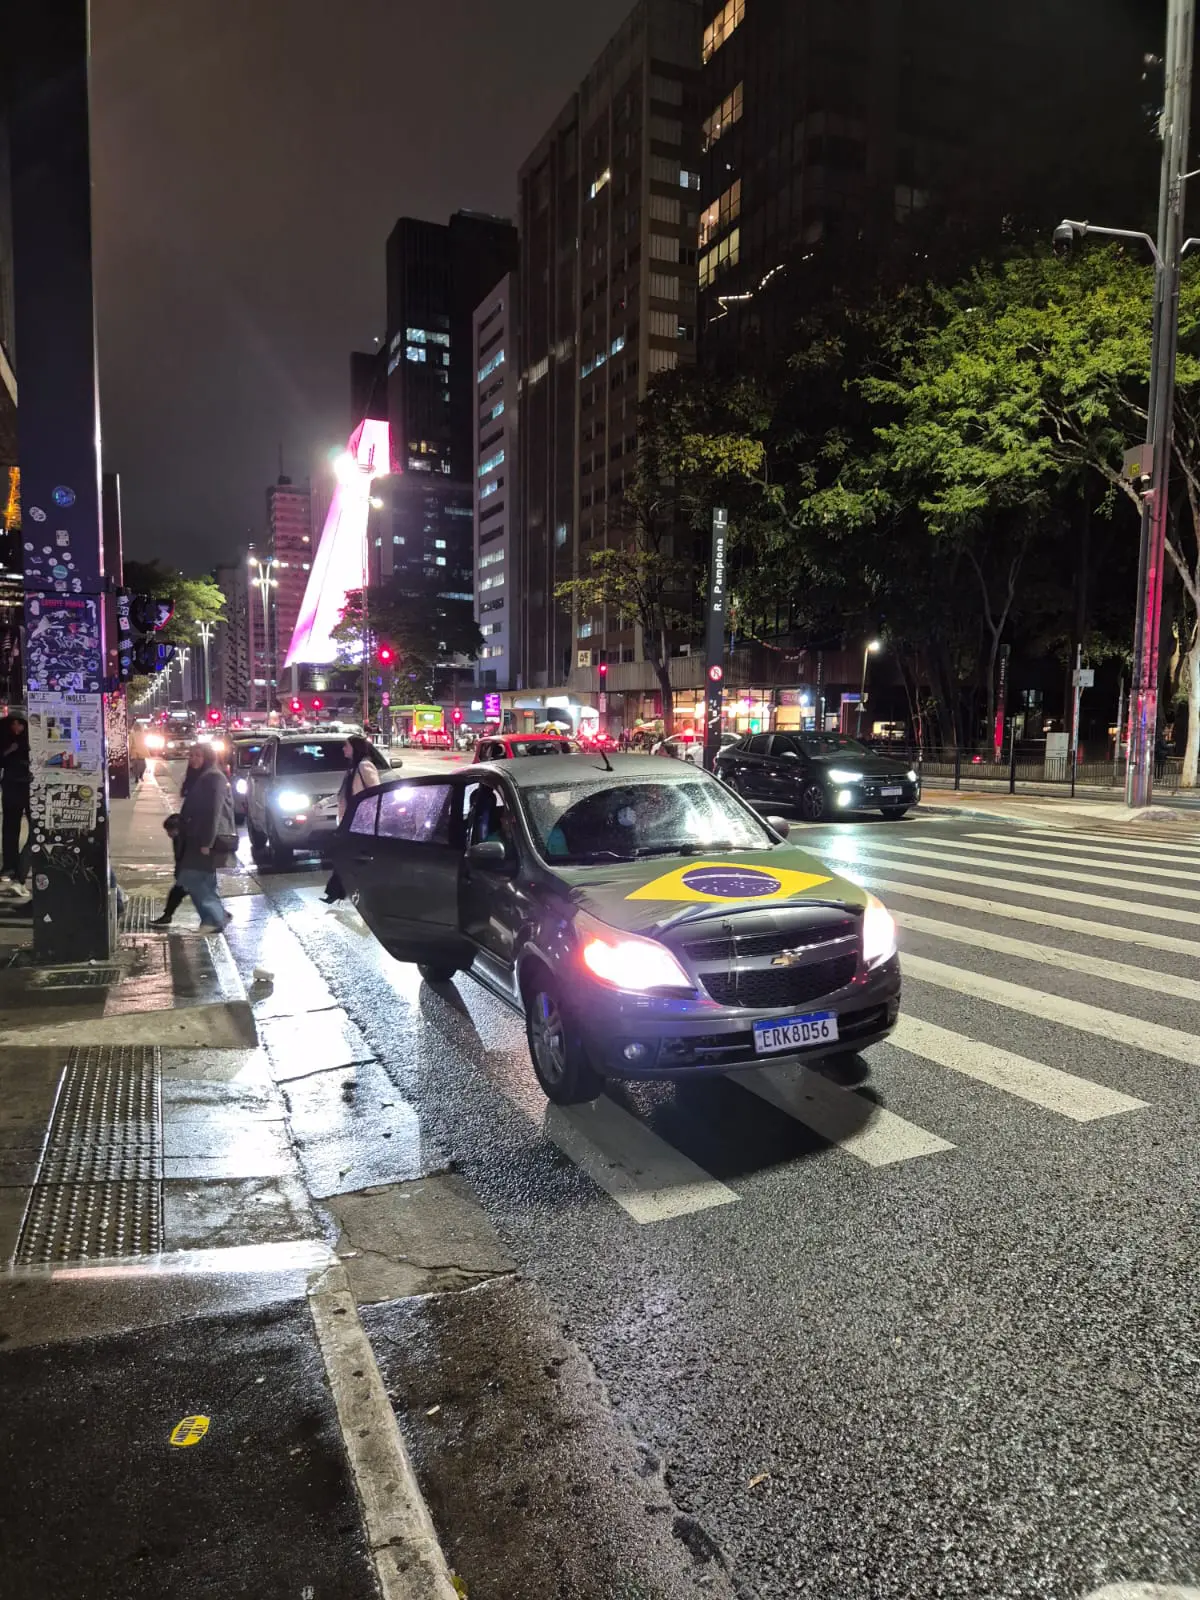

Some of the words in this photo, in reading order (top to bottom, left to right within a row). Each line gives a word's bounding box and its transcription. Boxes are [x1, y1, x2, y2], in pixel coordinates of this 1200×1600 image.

[714, 538, 725, 594] Pamplona
[713, 599, 722, 611] R.
[60, 792, 70, 800] DE
[762, 1020, 829, 1048] ERK8D56
